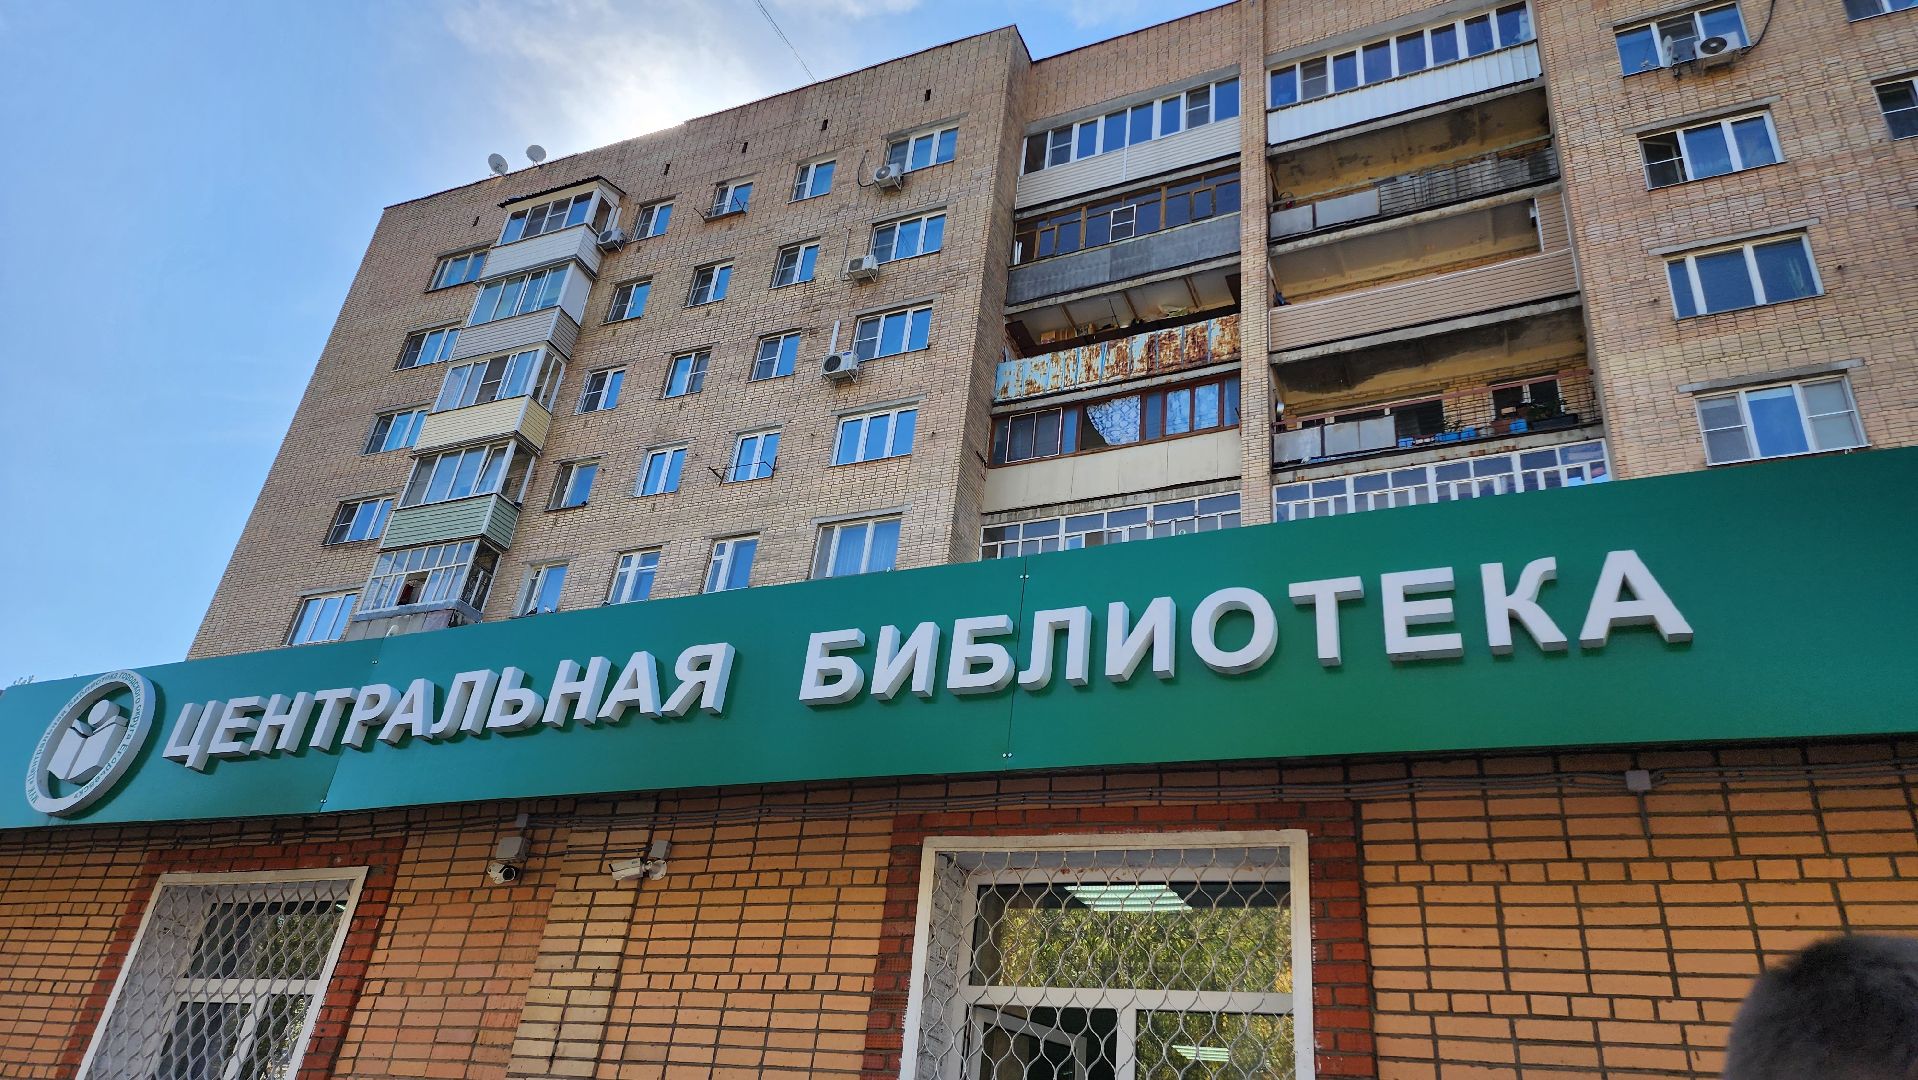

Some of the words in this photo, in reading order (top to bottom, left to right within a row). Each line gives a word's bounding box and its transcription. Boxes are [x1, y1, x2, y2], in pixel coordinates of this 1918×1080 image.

[126, 704, 142, 740] округа
[162, 642, 735, 773] ЦЕНТРАЛЬНАЯ
[798, 549, 1694, 706] БИБЛИОТЕКА
